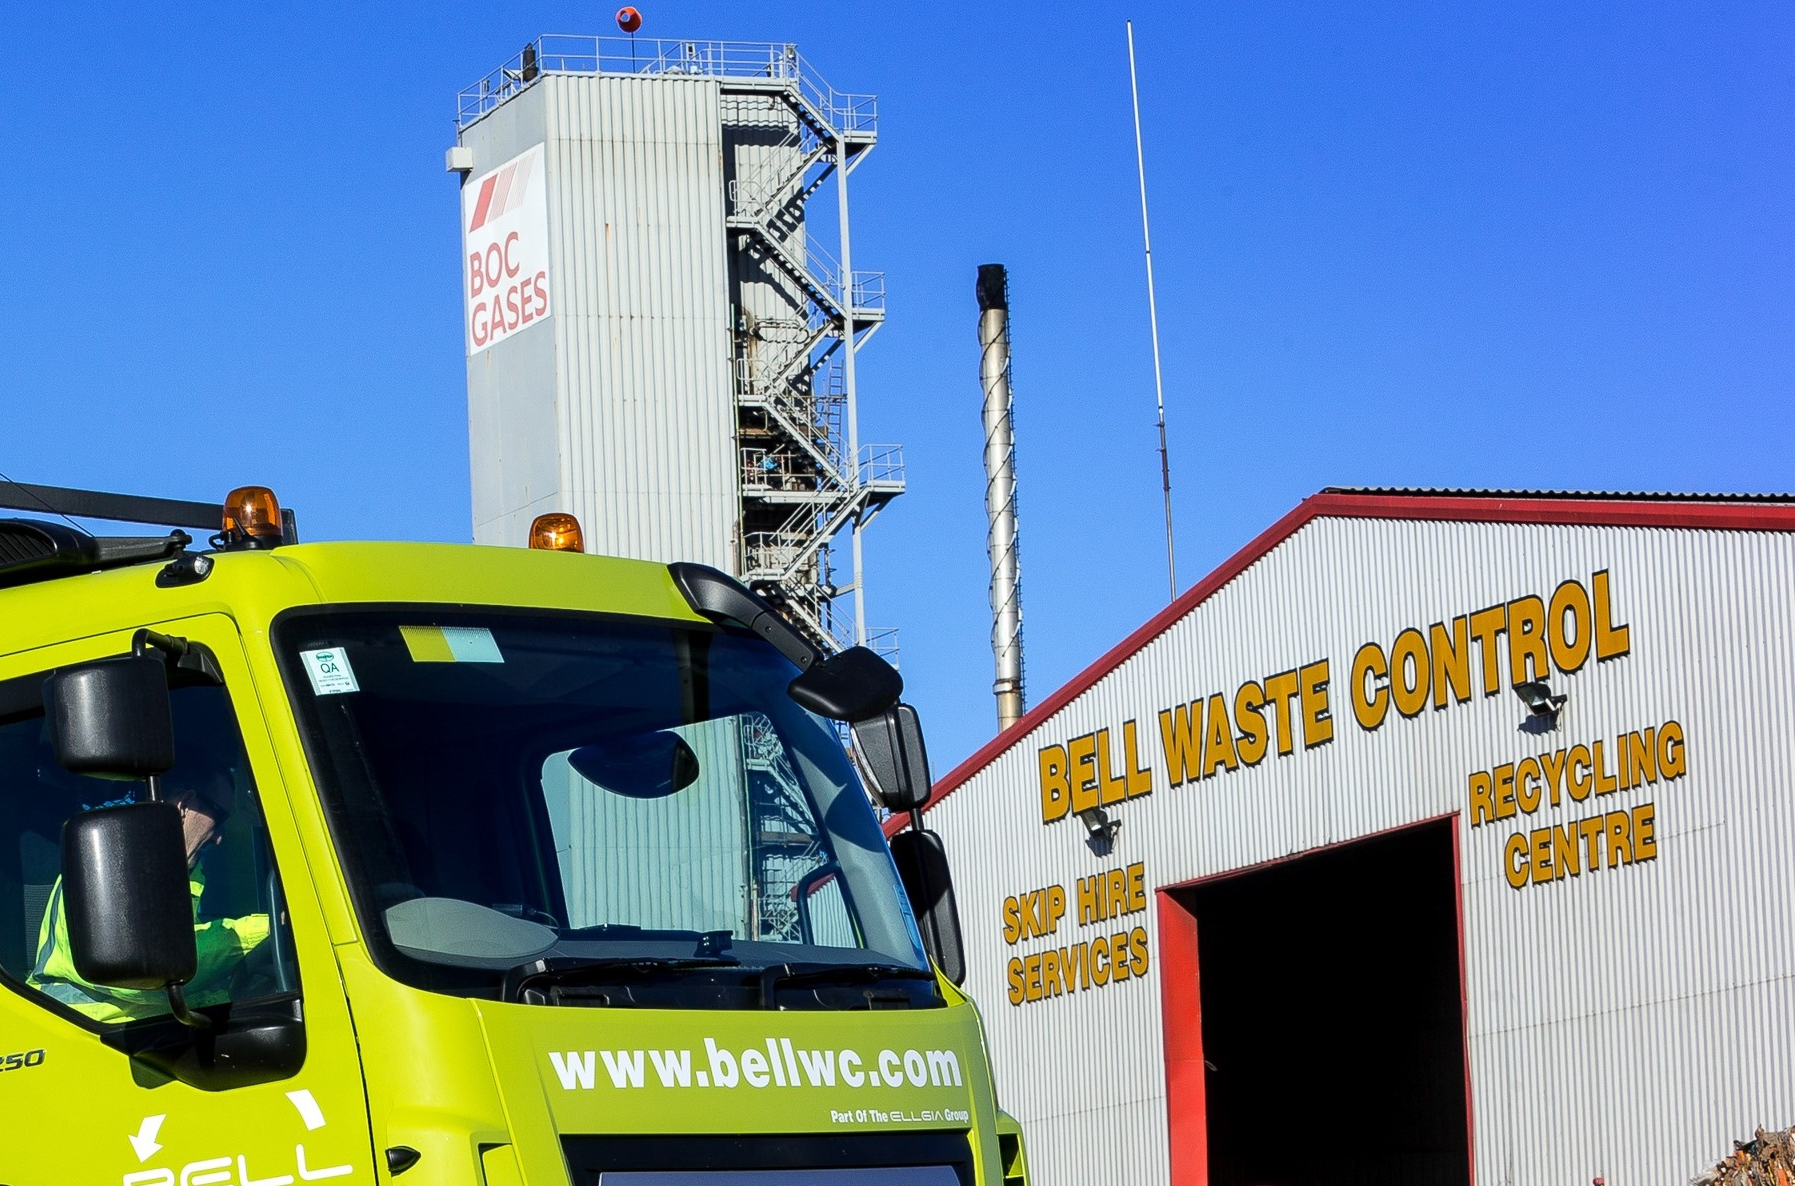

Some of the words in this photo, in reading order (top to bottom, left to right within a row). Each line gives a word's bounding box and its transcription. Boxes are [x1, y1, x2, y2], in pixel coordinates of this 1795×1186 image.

[470, 231, 520, 299] BOC
[472, 271, 548, 347] GASES
[320, 662, 340, 674] QA
[1037, 718, 1153, 826] BELL
[1158, 657, 1335, 789] WASTE
[1349, 567, 1631, 733] CONTROL
[1468, 720, 1687, 828] RECYCLING
[1503, 802, 1658, 891] CENTRE
[1002, 883, 1065, 947] SKIP
[1077, 861, 1147, 928] HIRE
[1006, 926, 1150, 1006] SERVICES
[548, 1037, 963, 1091] www.bellwc.com
[830, 1109, 854, 1123] Part
[855, 1109, 868, 1123] Of
[869, 1109, 888, 1123] The
[944, 1108, 969, 1124] Group
